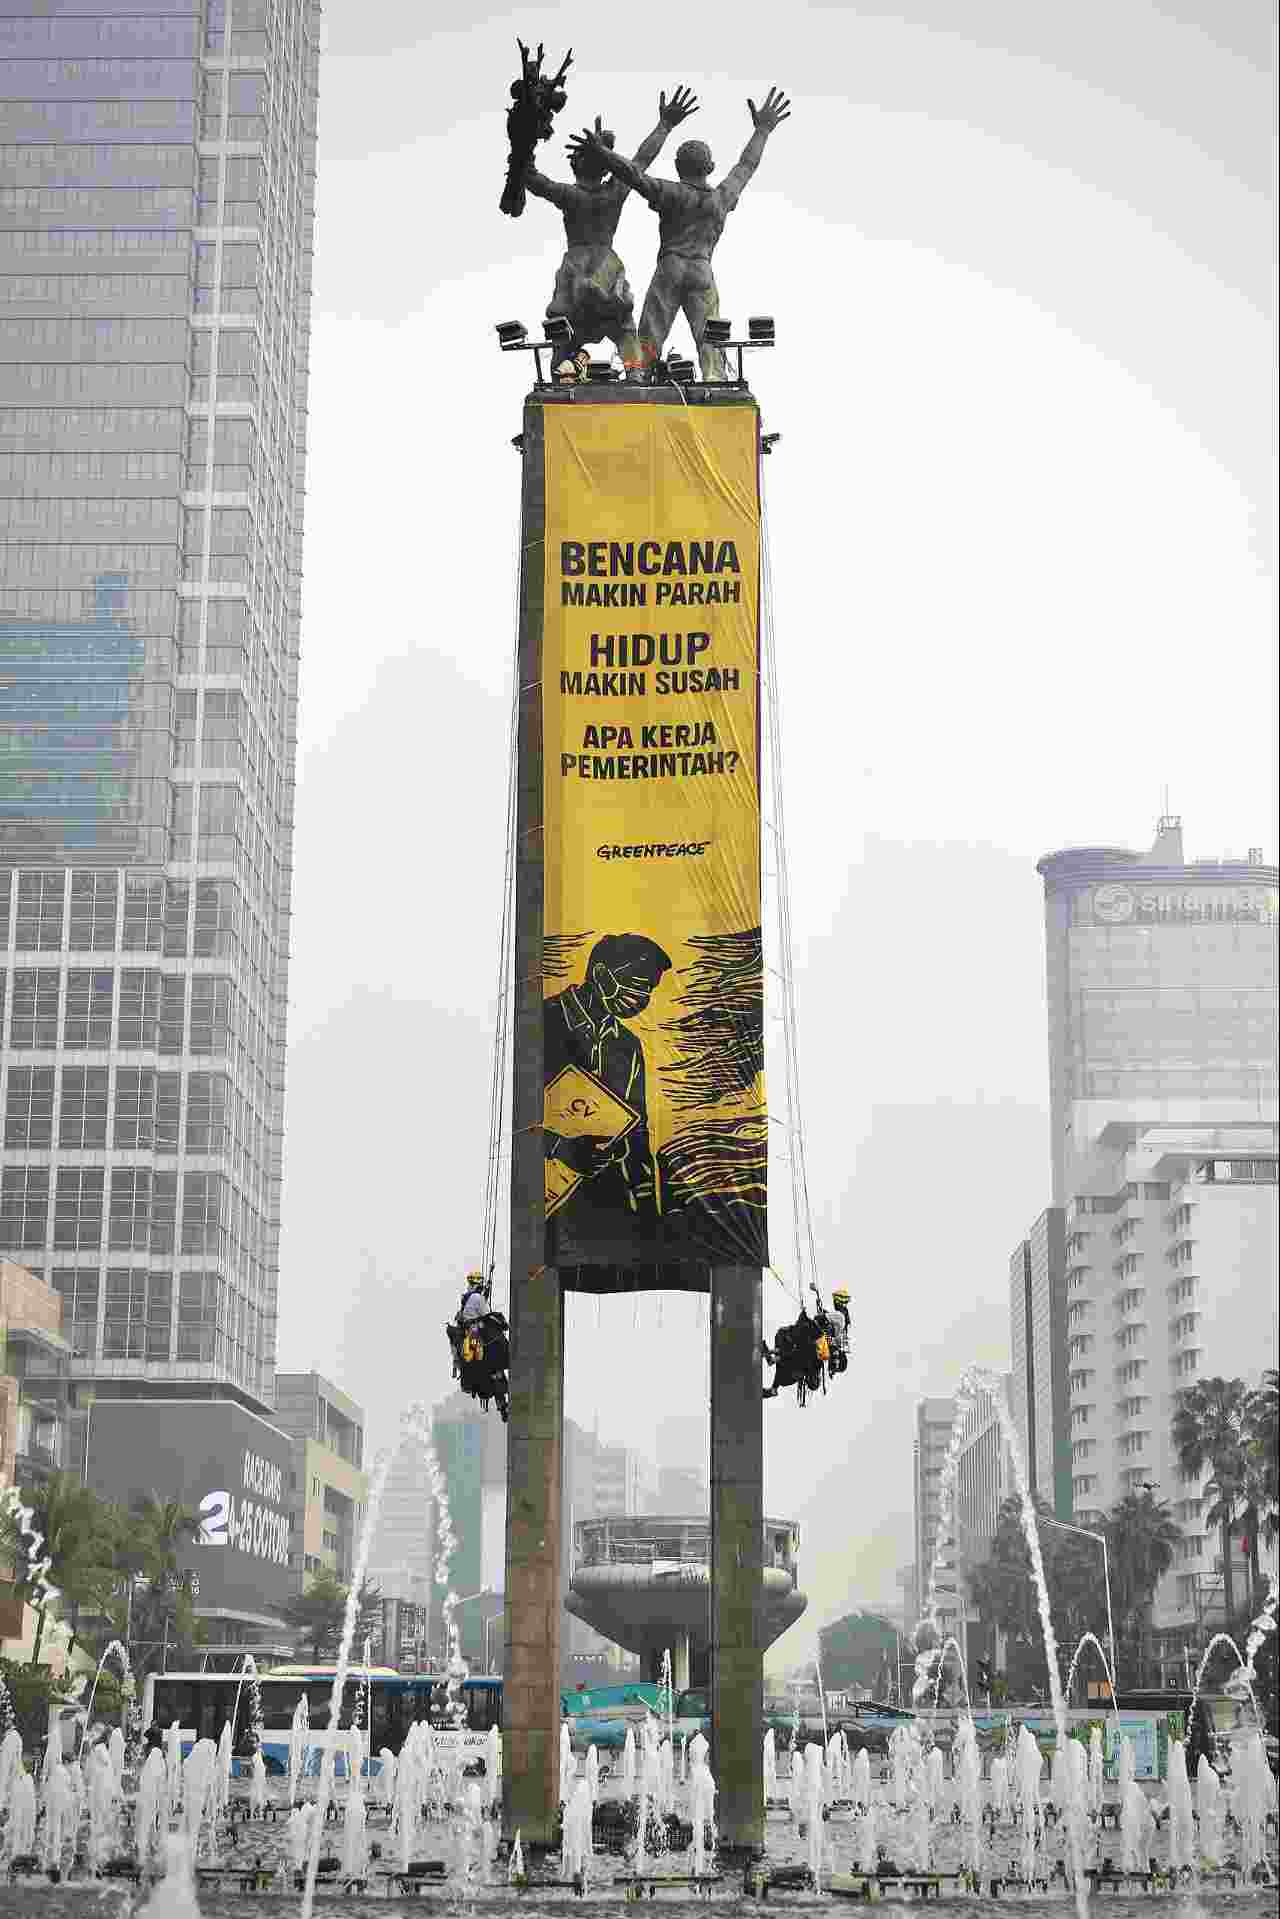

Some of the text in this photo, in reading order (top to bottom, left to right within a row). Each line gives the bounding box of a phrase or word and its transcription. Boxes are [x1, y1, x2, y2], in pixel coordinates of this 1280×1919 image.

[561, 541, 741, 577] BENCANA
[561, 580, 741, 607] MAKIN PARAH
[590, 632, 711, 668] HIDUP
[560, 668, 740, 696] MAKIN SUSAH
[583, 722, 717, 749] APA KERJA
[560, 751, 739, 780] PEMERINTAH?
[597, 841, 711, 860] GREENPEACE
